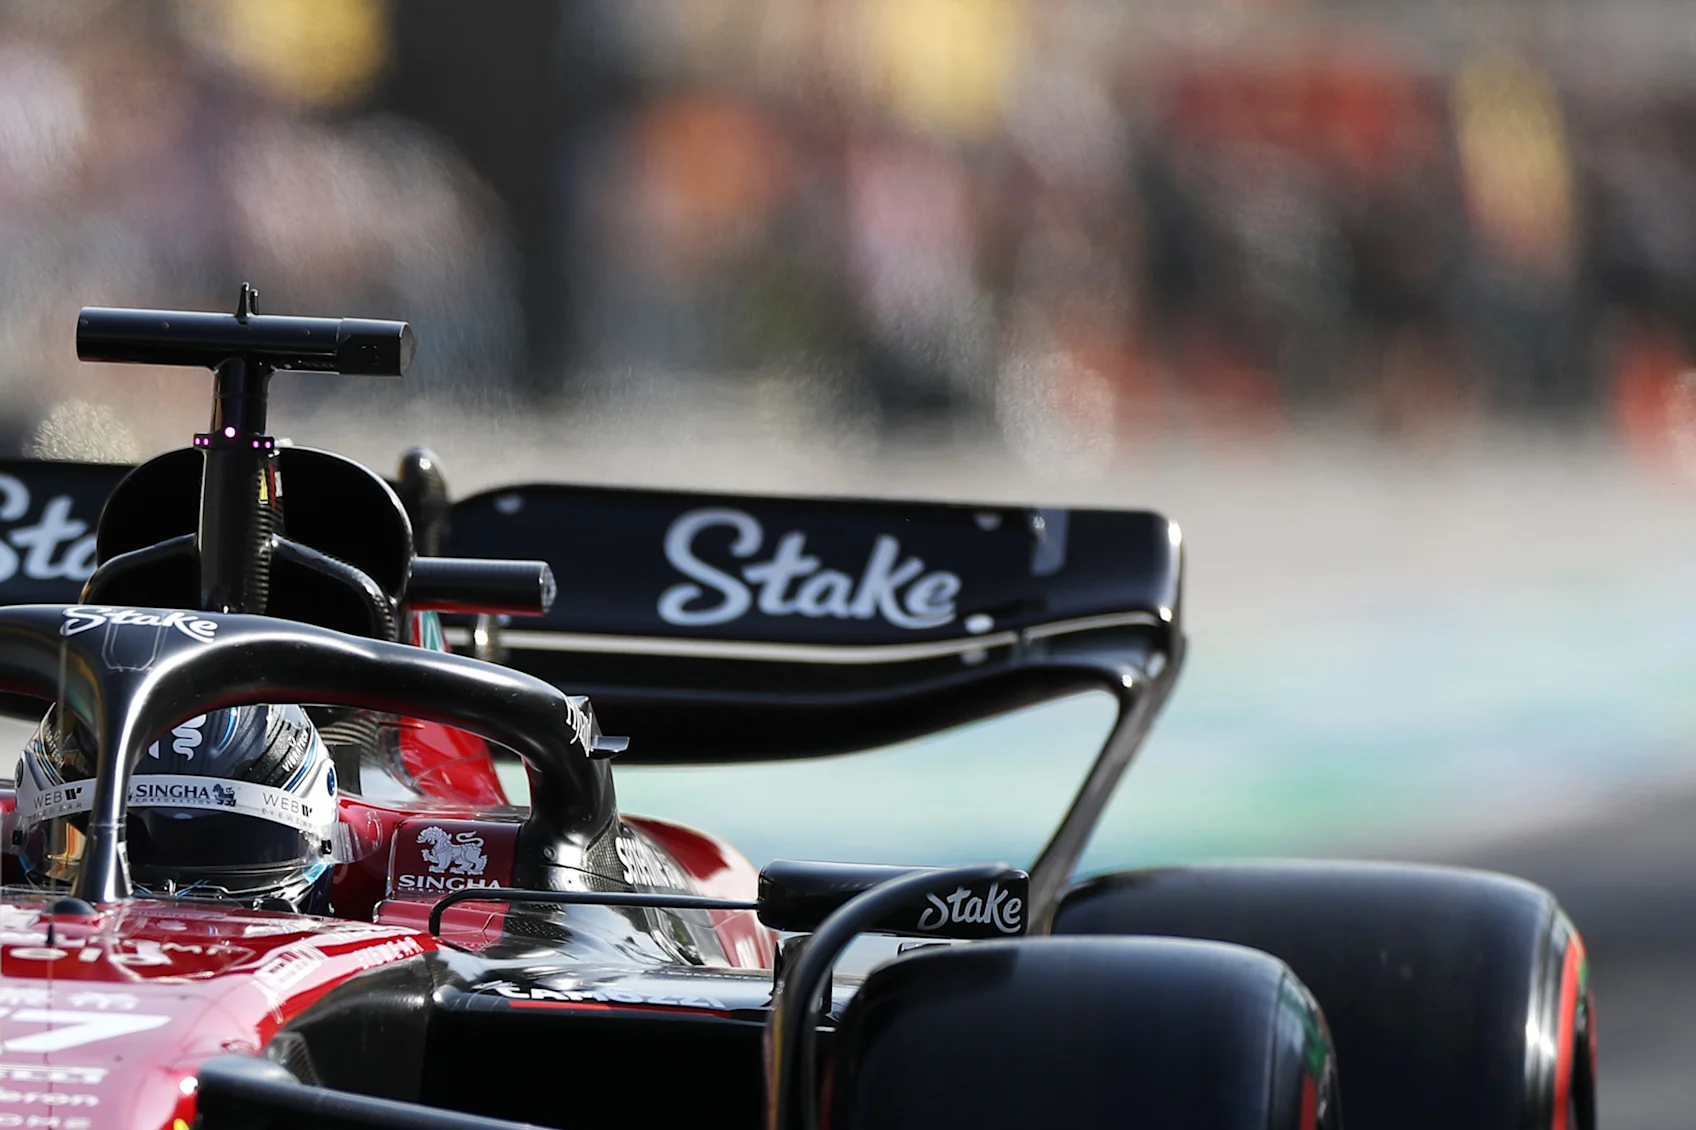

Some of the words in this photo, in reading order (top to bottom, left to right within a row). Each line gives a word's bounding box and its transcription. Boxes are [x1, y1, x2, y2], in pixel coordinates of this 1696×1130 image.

[657, 508, 961, 629] Stake
[60, 606, 219, 643] Stake
[34, 790, 63, 809] WEB
[136, 784, 210, 799] SINGHA
[262, 792, 300, 814] WEB
[398, 874, 501, 890] SINGHA
[917, 882, 1022, 933] Stake
